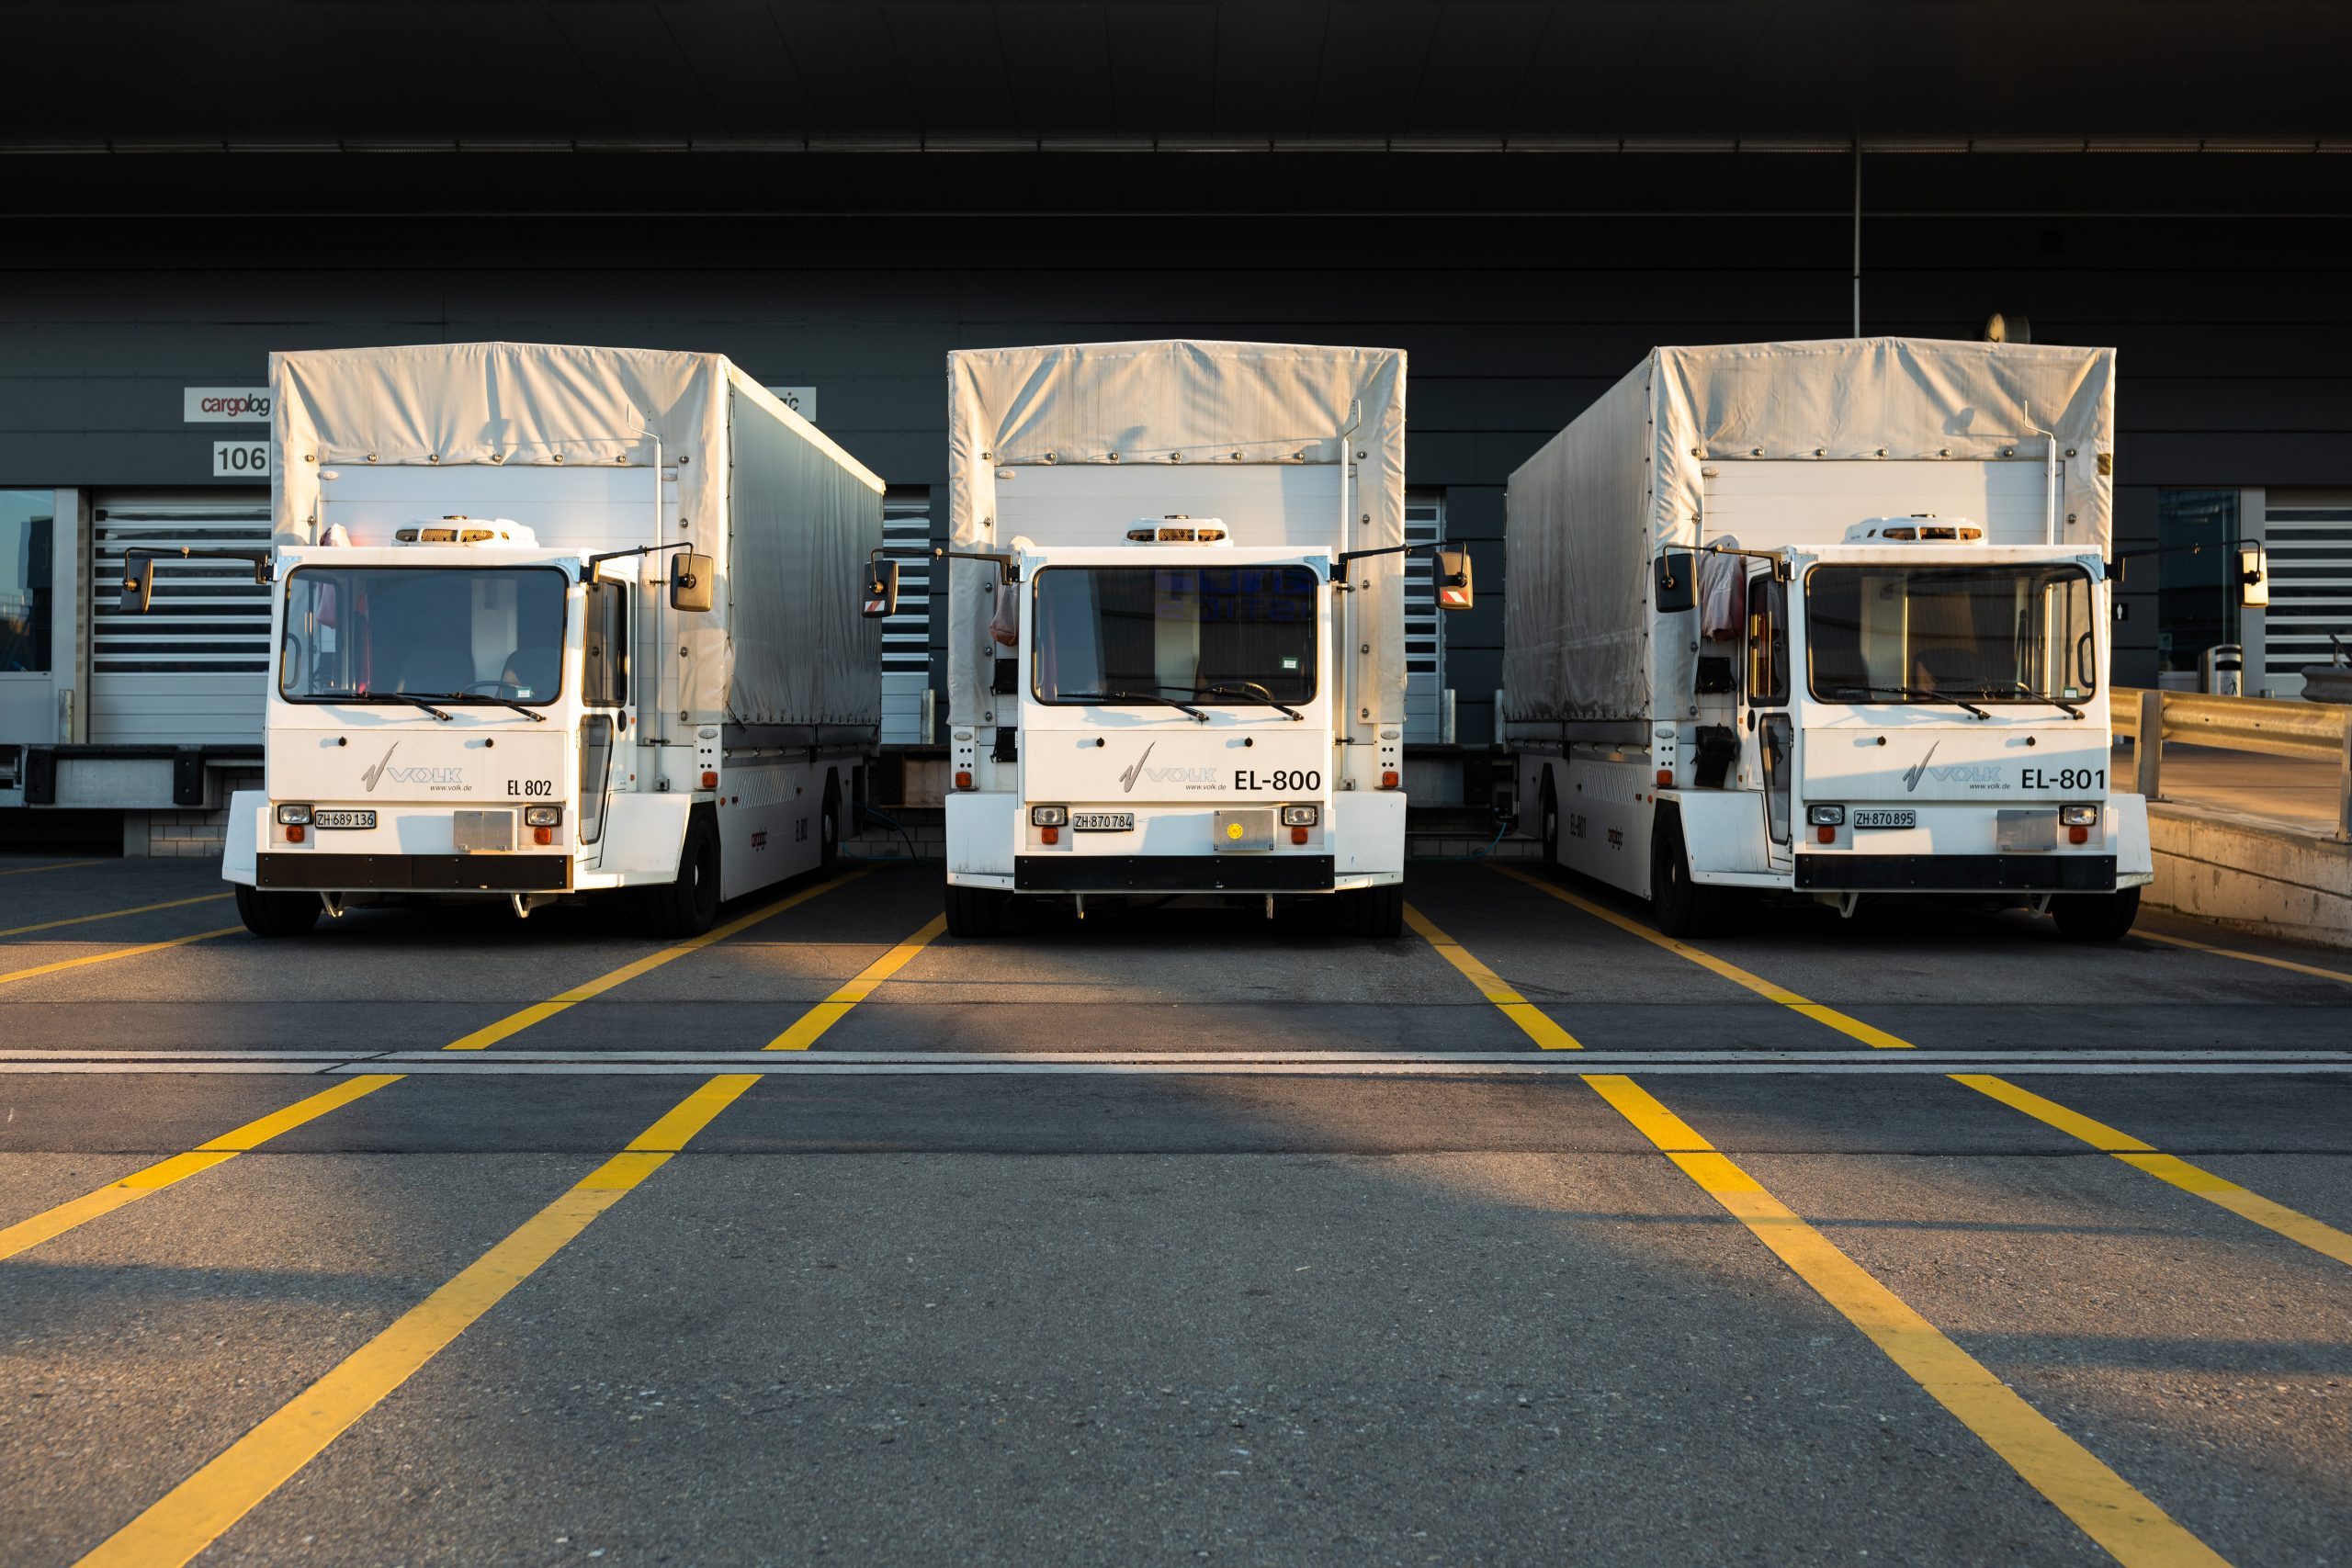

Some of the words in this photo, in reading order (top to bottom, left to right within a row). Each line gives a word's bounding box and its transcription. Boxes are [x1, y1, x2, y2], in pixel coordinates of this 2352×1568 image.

[218, 447, 266, 470] 106
[387, 768, 462, 784] VOLK
[1144, 767, 1217, 783] VOLK
[1235, 770, 1321, 791] EL-800
[1928, 766, 2002, 782] VOLK
[2021, 768, 2105, 790] EL-801
[507, 780, 520, 795] EL
[525, 780, 551, 796] 802
[355, 814, 374, 826] 136
[1113, 816, 1132, 828] 784
[1894, 813, 1914, 826] 895
